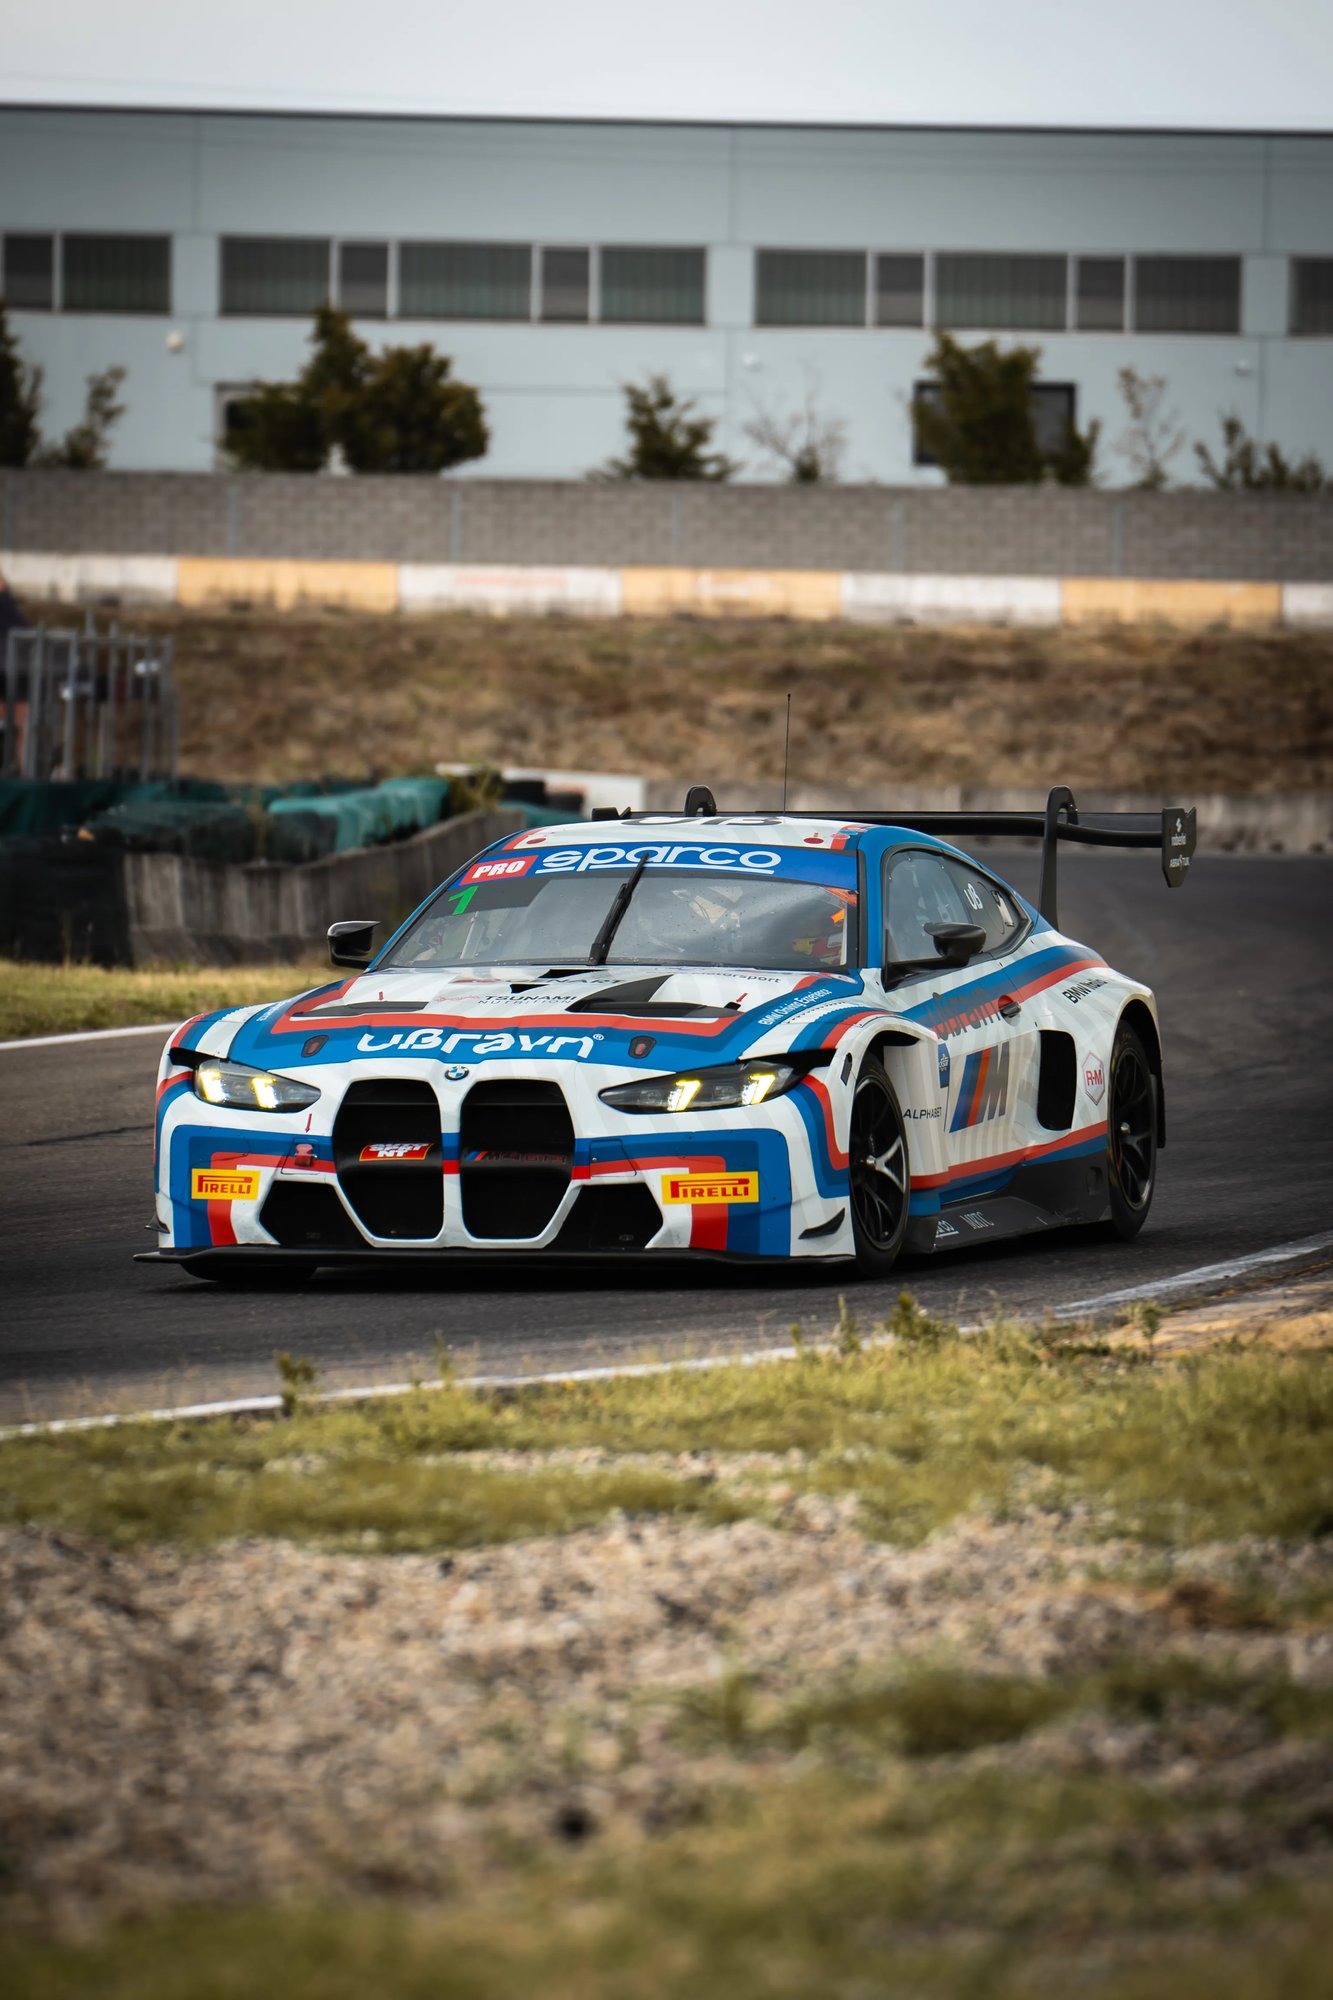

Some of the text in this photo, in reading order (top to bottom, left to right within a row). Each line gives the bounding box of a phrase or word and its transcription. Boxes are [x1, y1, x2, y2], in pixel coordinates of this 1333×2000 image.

[471, 860, 526, 879] PRO
[541, 845, 782, 873] sparco
[447, 885, 480, 916] 1
[483, 994, 578, 1002] TSUNAMI
[1061, 983, 1092, 1004] BMW
[903, 1106, 943, 1120] ALPHABET
[197, 1174, 253, 1195] PIRELLI
[670, 1177, 750, 1199] PIRELLI
